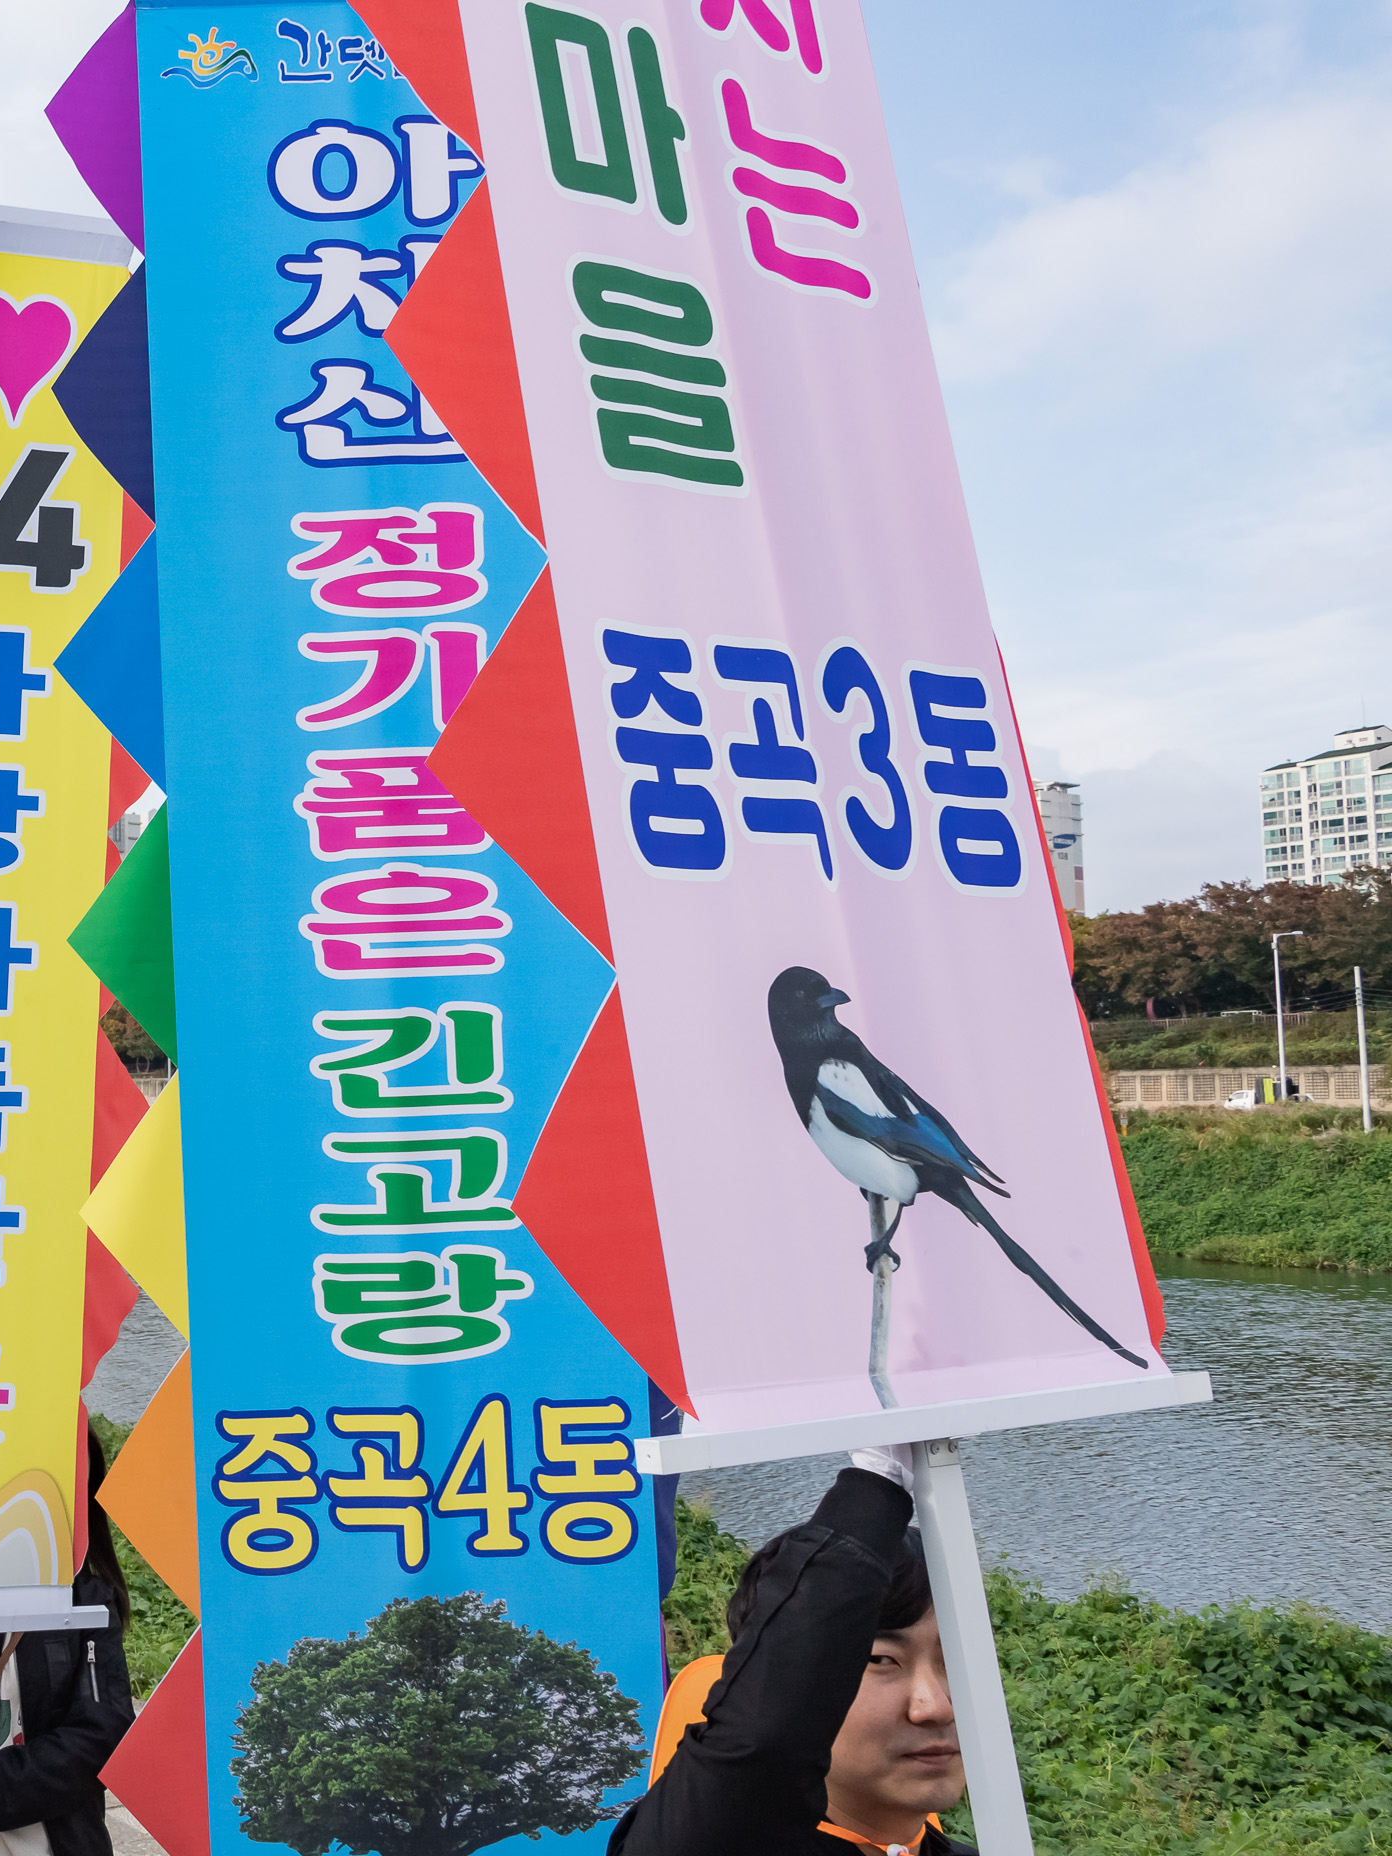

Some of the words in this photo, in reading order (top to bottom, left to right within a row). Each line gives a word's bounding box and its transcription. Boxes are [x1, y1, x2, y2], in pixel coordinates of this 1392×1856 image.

[275, 18, 410, 83] 간뎃
[595, 619, 1025, 892] 중곡3동
[309, 1002, 533, 1364] 긴고랑
[212, 1393, 643, 1574] 중곡4동
